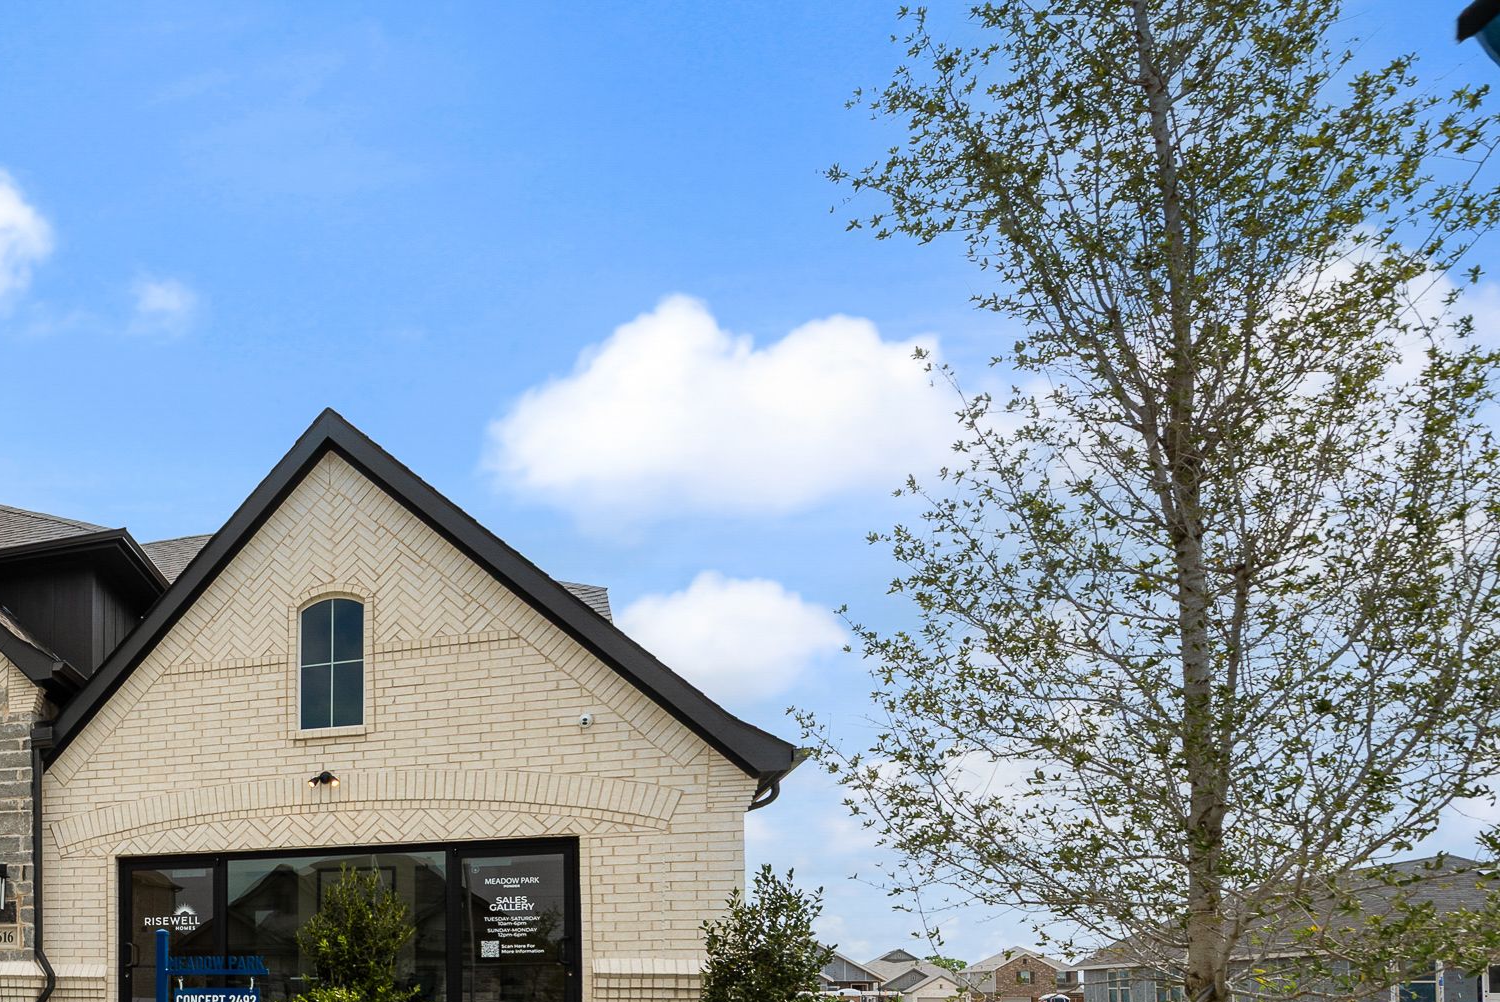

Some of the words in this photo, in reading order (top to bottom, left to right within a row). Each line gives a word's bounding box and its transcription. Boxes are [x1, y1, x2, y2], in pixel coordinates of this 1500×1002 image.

[496, 896, 527, 904] SALES
[489, 903, 534, 911] GALLERY
[144, 916, 200, 925] RISEWELL
[169, 955, 224, 970] MEADOW
[228, 955, 264, 970] PARK
